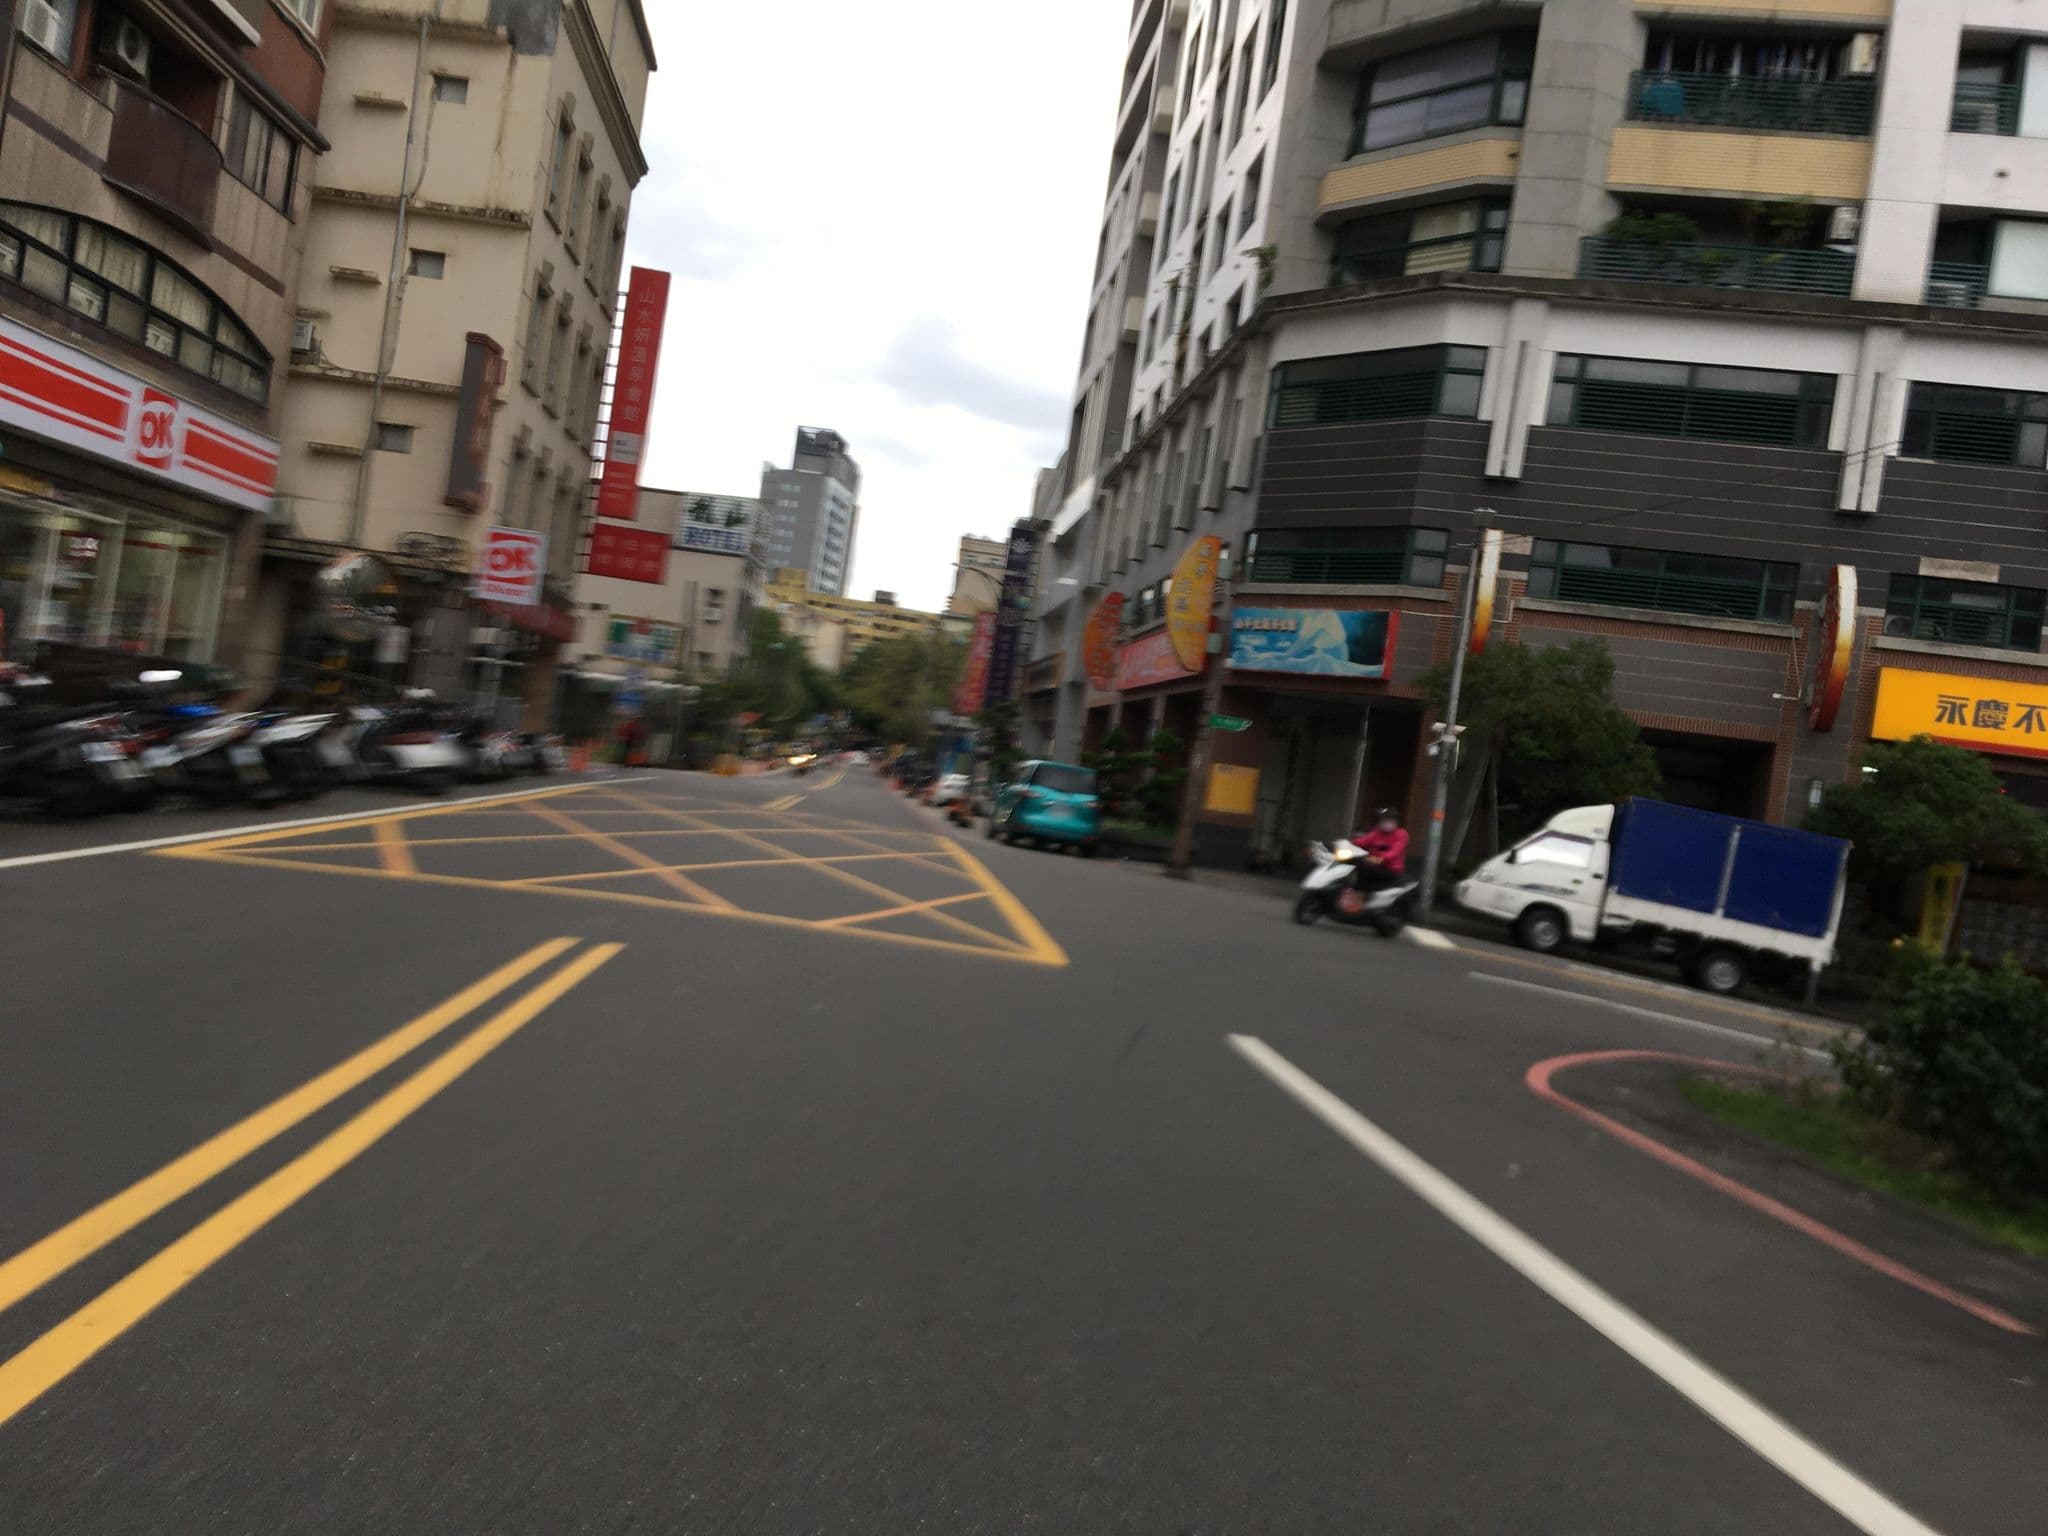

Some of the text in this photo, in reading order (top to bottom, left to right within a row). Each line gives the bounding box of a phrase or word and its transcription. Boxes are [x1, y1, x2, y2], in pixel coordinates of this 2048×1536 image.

[140, 410, 176, 449] OK
[488, 547, 537, 572] OK
[1934, 694, 2048, 733] 永慶不
